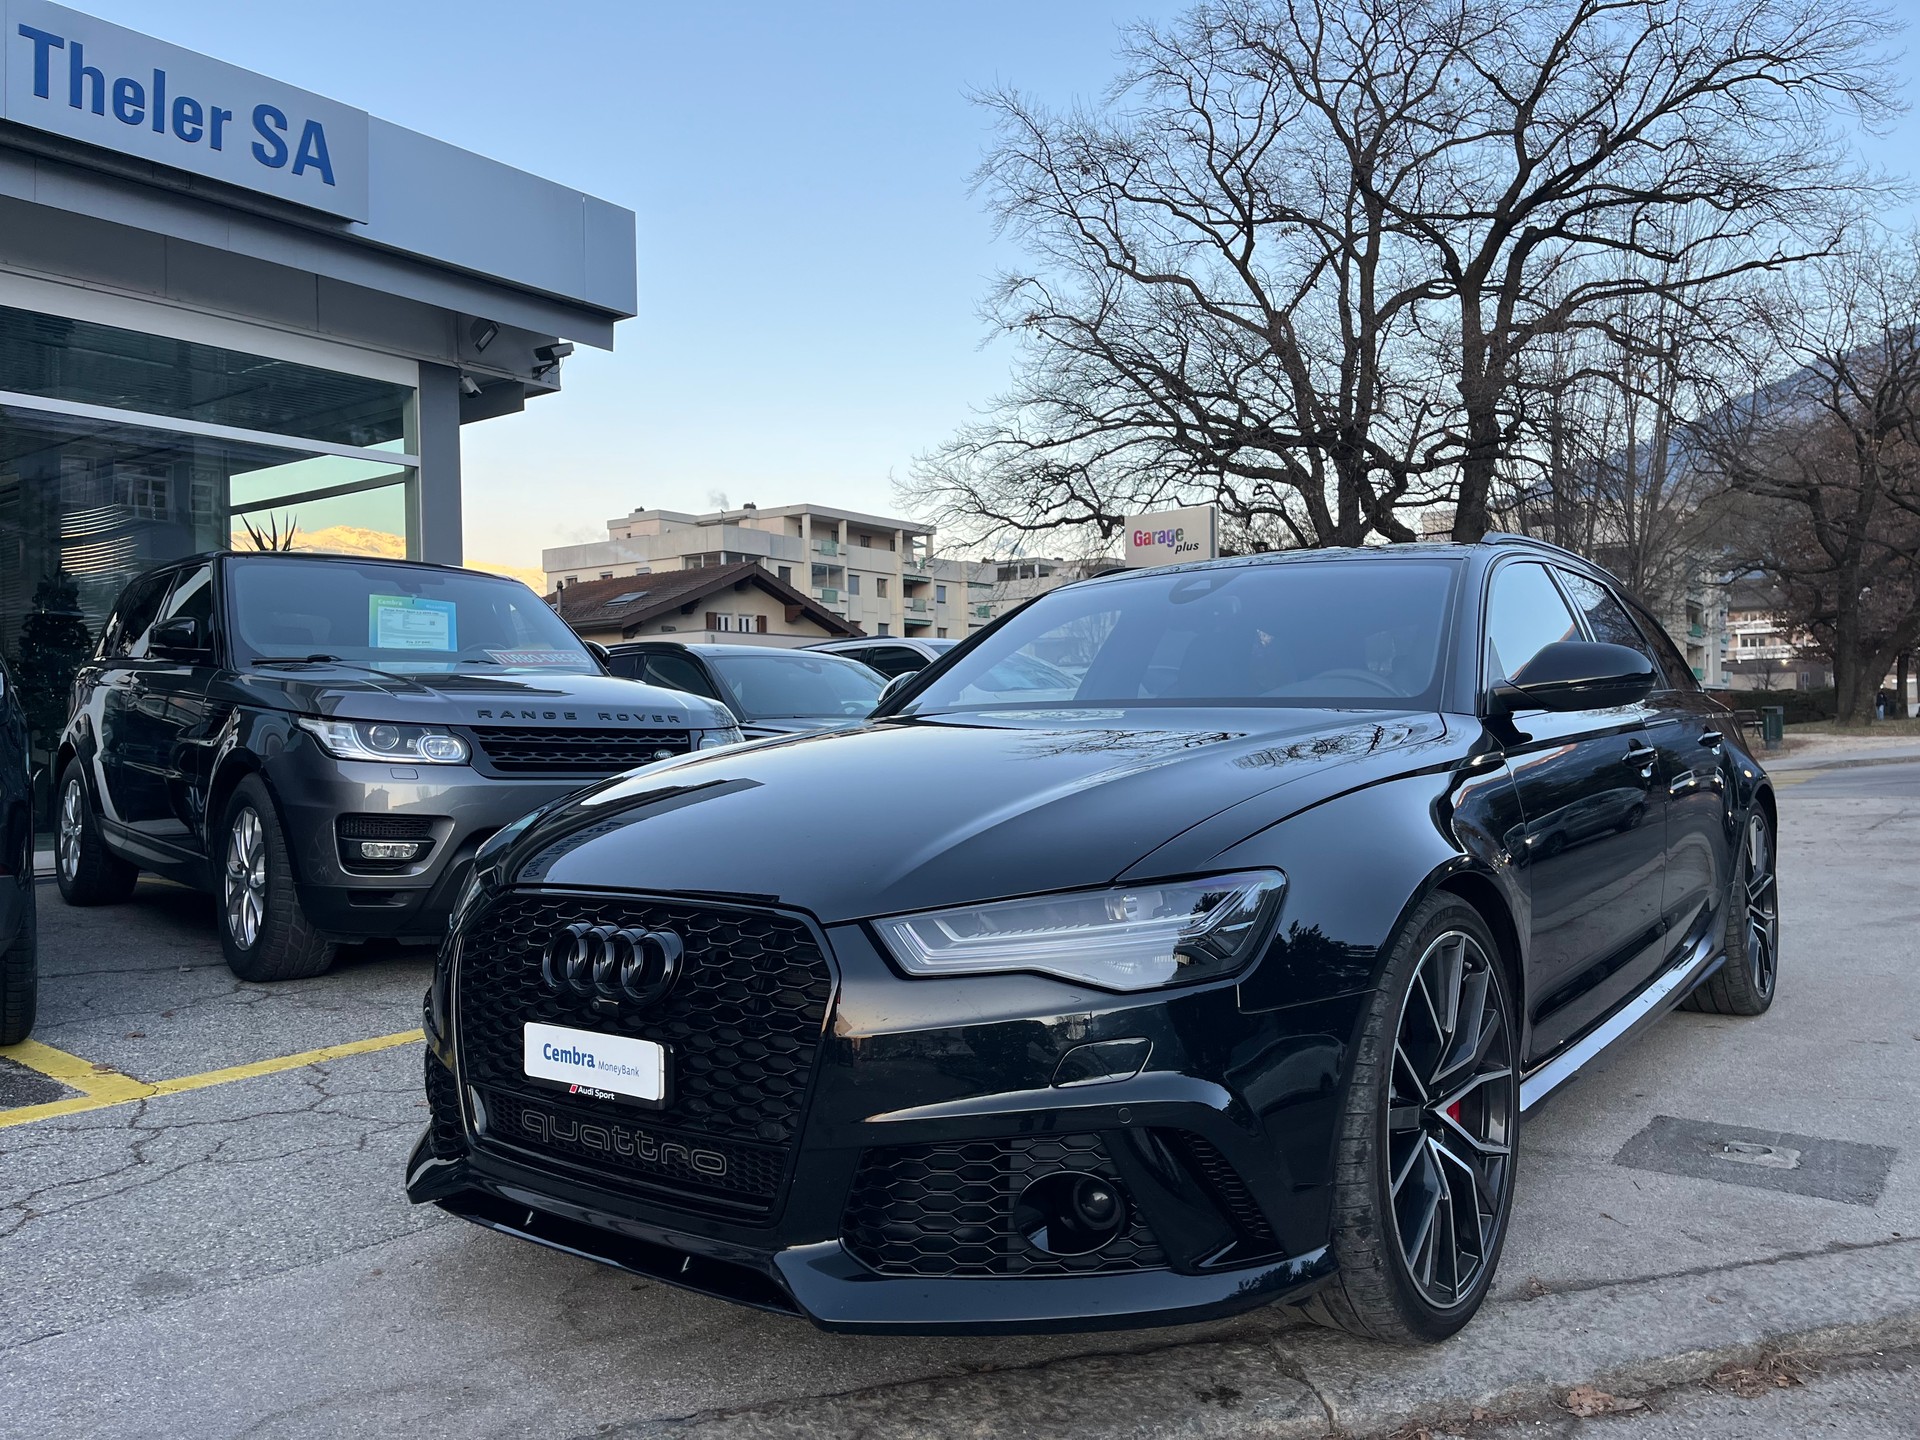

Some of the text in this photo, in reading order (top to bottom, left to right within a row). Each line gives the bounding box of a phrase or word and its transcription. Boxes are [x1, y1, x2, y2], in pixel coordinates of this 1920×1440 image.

[18, 23, 336, 187] Theler SA
[1134, 528, 1184, 548] Garage
[1175, 542, 1200, 554] plus
[491, 653, 589, 664] TURBO-DIESEL
[477, 709, 681, 723] RANGE ROVER
[543, 1043, 640, 1077] Cembra MoneyBank
[578, 1086, 615, 1100] Audi Sport
[521, 1109, 727, 1176] quattro
